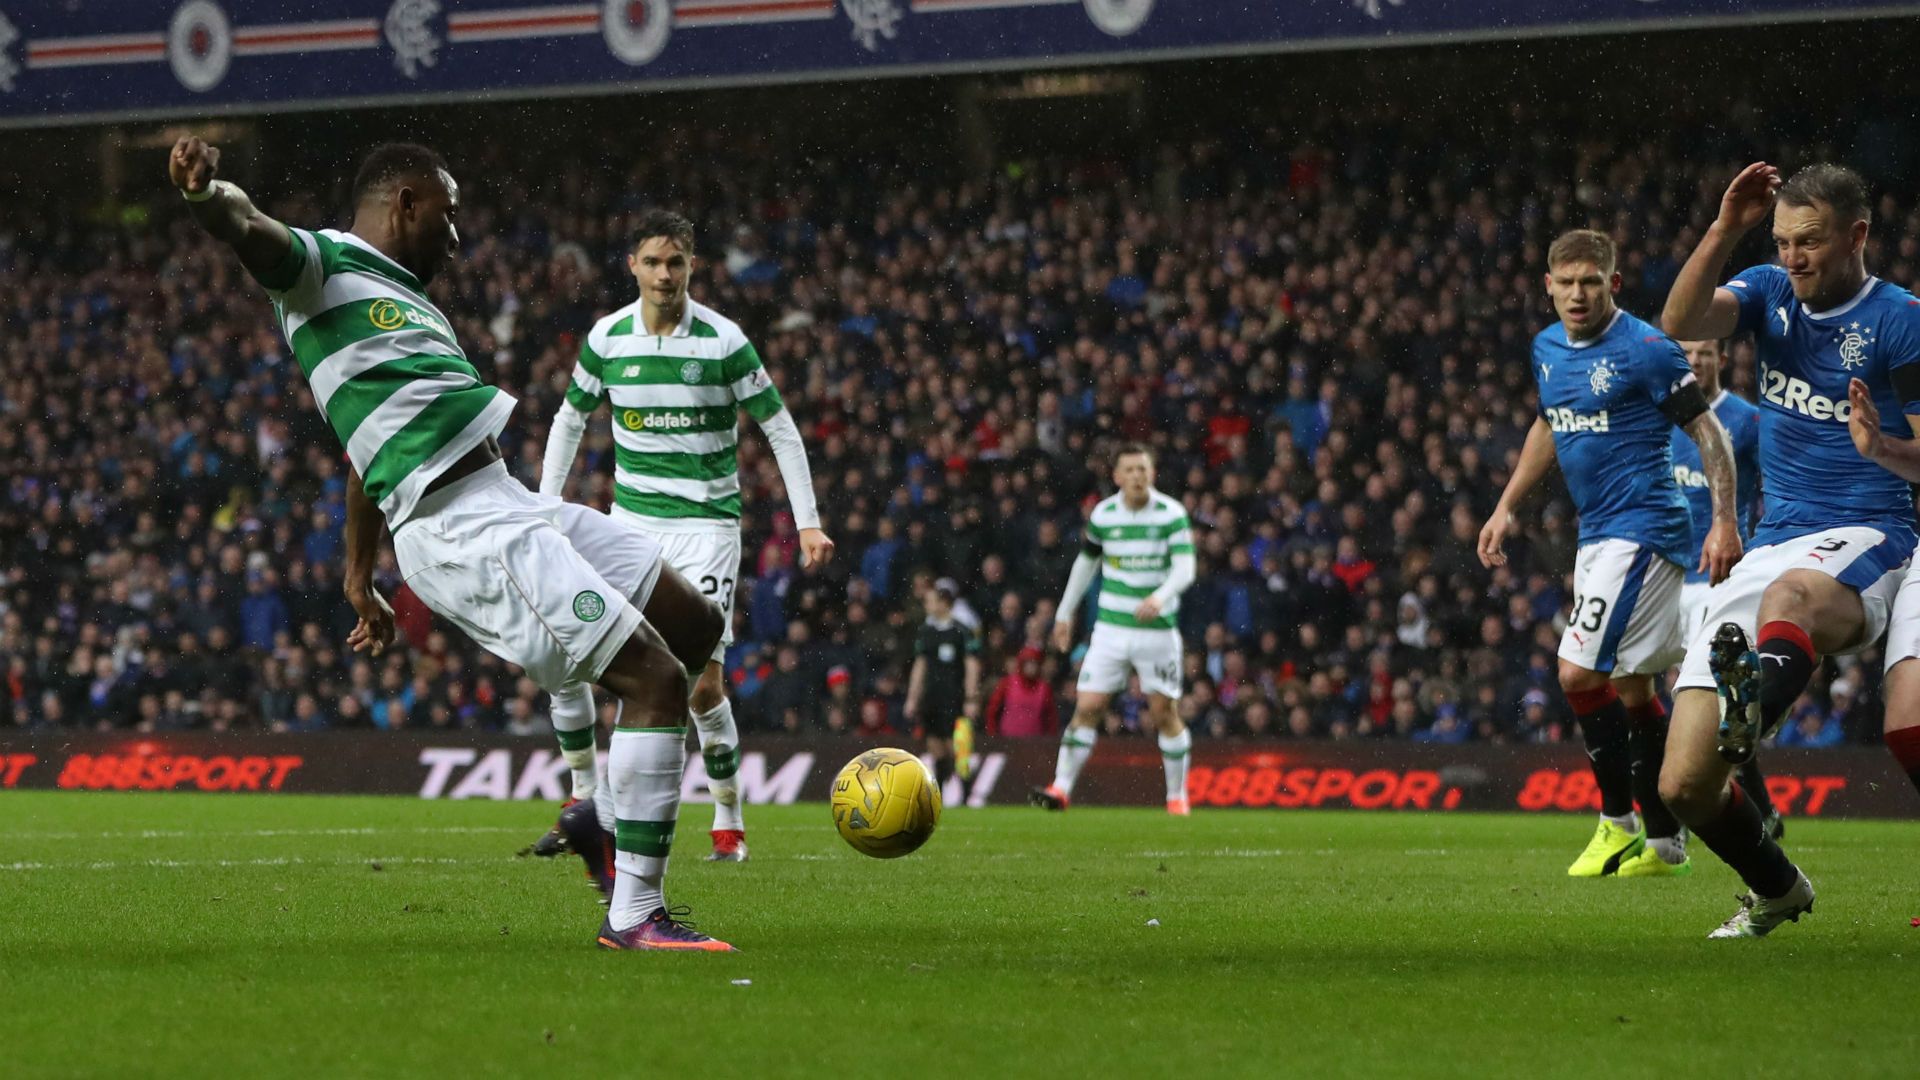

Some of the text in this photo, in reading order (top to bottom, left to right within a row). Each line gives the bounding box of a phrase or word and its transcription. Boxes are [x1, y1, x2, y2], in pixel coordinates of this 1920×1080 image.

[643, 412, 706, 429] dafabet
[57, 753, 303, 790] 888SPORT
[418, 748, 608, 799] TAK
